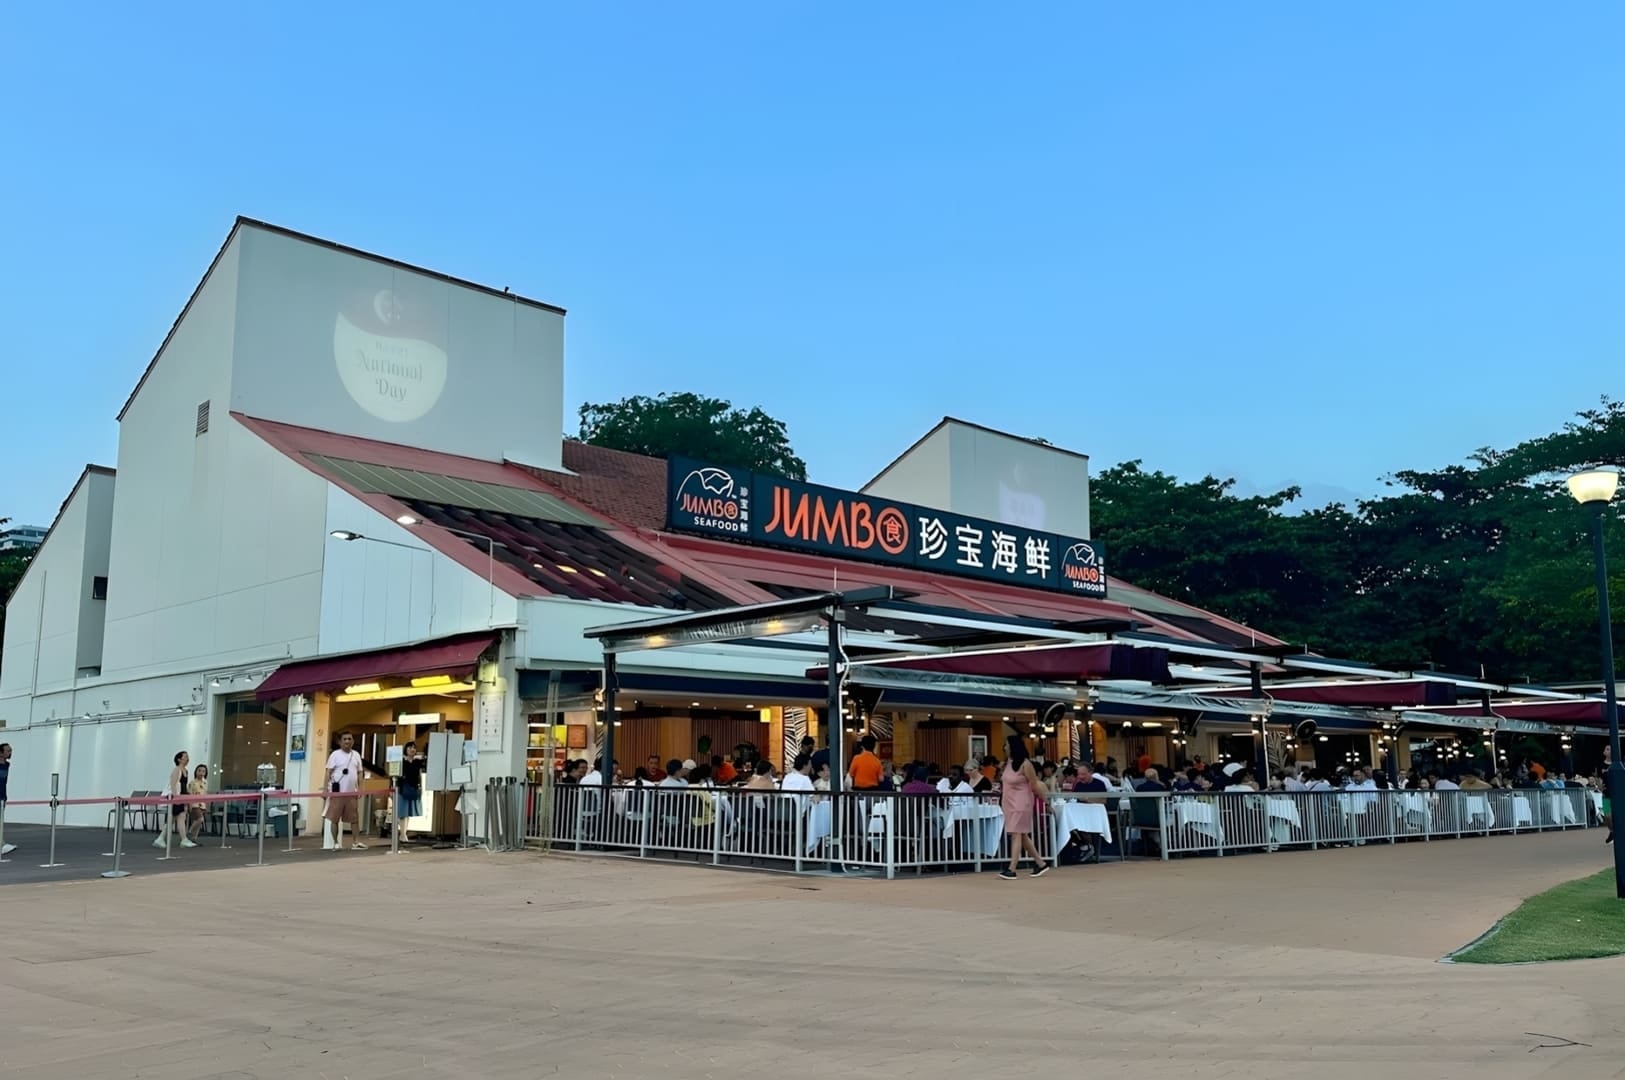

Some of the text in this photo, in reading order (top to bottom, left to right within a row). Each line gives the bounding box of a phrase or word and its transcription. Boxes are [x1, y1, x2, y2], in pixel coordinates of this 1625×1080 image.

[359, 349, 424, 383] National
[375, 377, 408, 401] Day
[680, 493, 738, 520] JUMBO
[764, 486, 909, 554] JUMBO
[694, 516, 739, 531] SEAFOOD
[918, 516, 1052, 579] 珍宝海鲜
[1064, 564, 1099, 583] JUMBO
